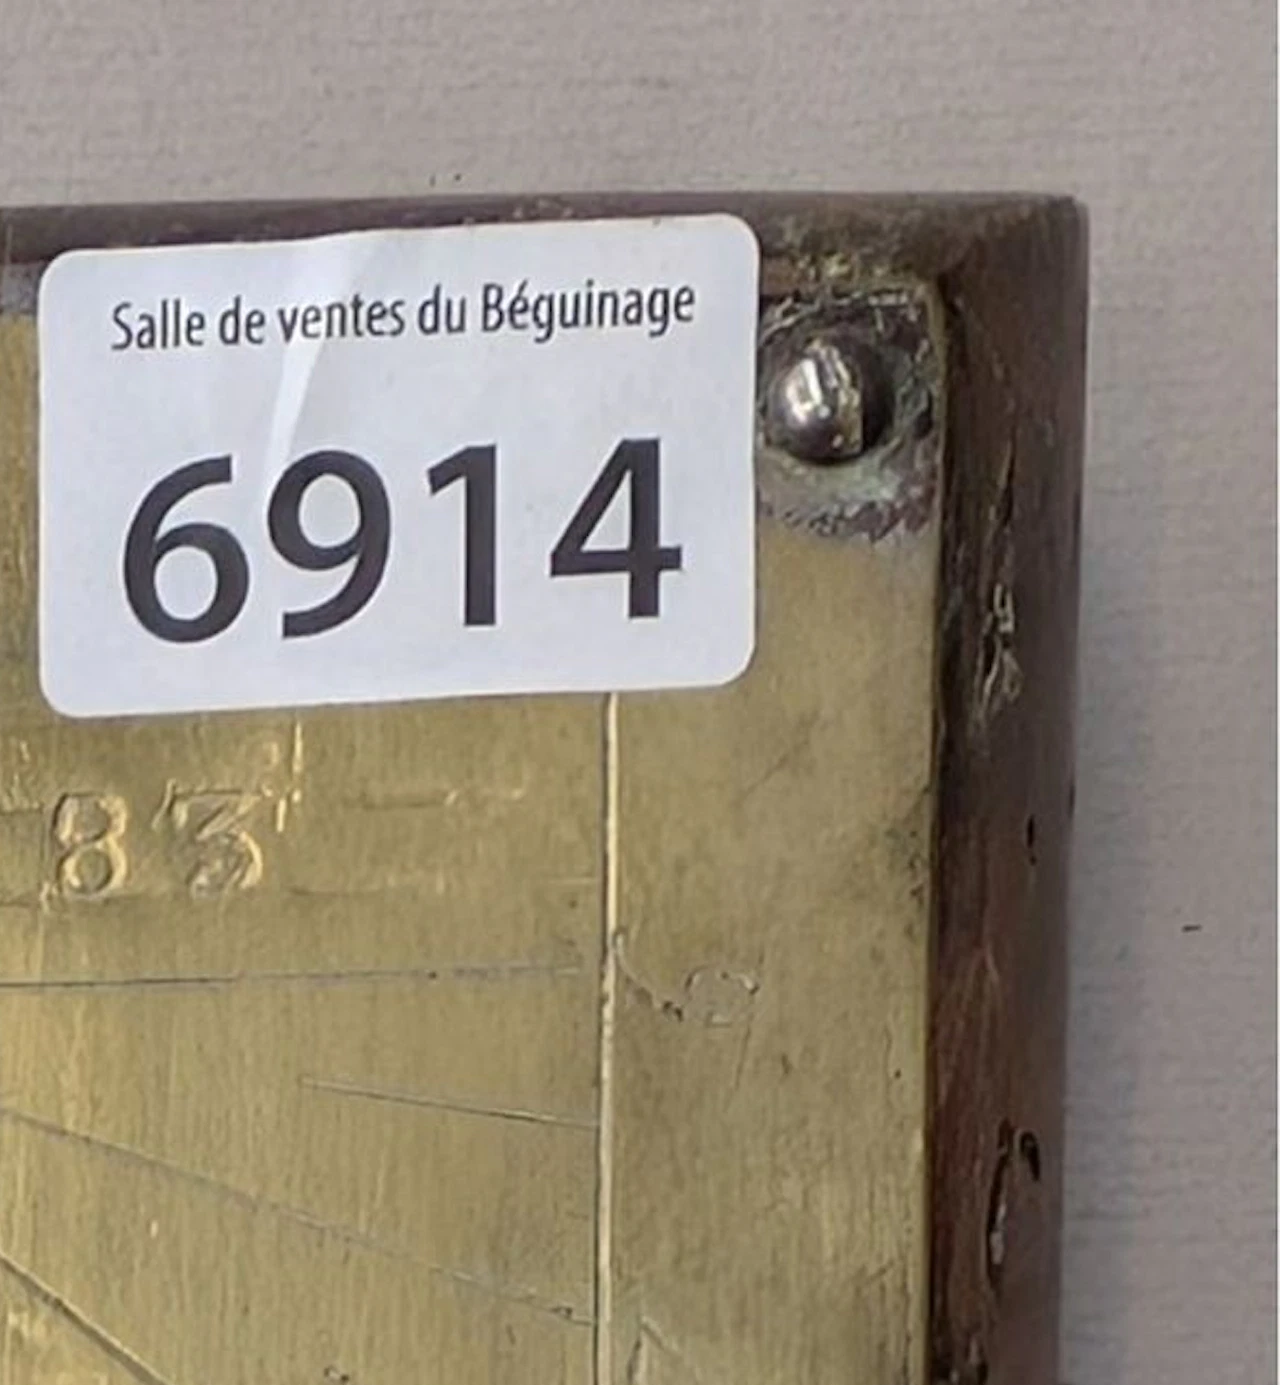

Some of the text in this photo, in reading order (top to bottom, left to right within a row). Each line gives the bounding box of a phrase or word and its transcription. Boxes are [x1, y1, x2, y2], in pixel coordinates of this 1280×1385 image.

[111, 280, 696, 351] Salle de ventes du Béguinage
[122, 437, 683, 644] 6914
